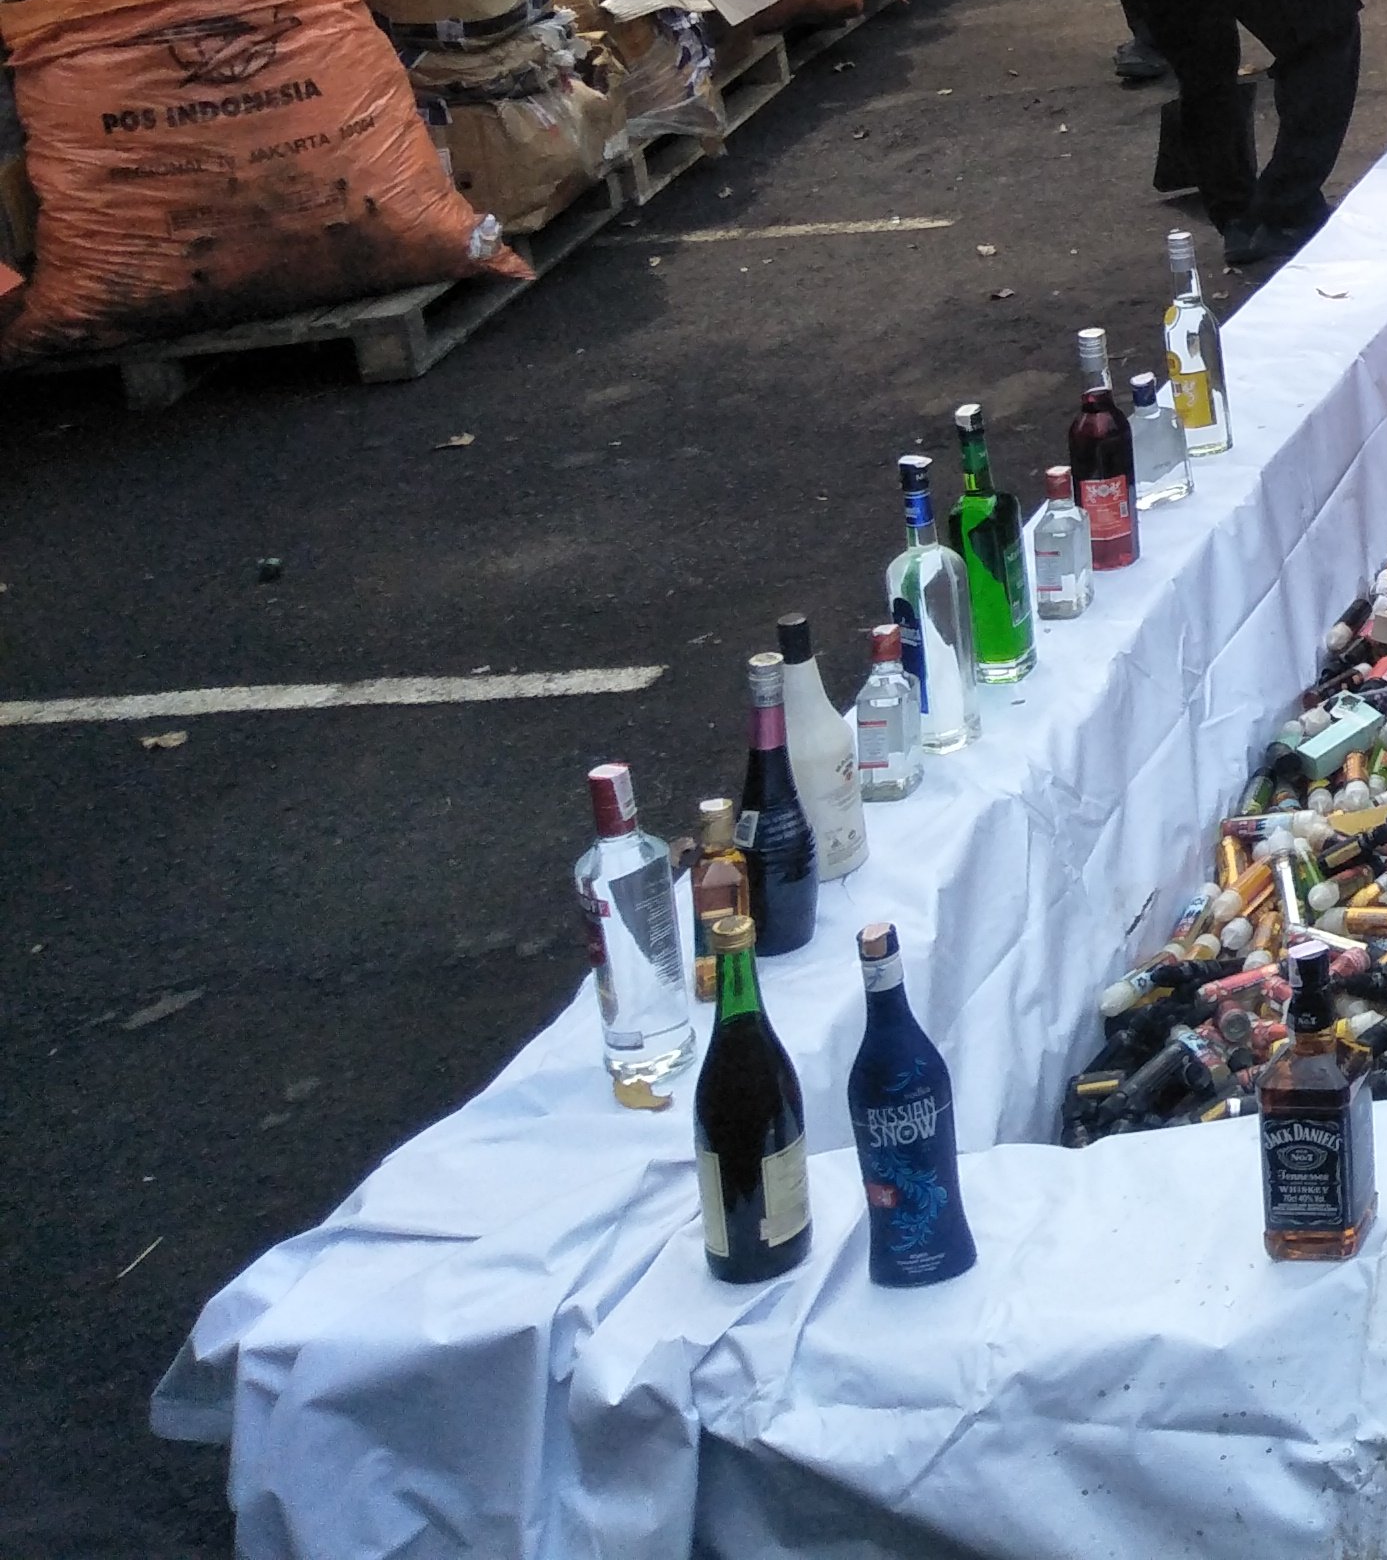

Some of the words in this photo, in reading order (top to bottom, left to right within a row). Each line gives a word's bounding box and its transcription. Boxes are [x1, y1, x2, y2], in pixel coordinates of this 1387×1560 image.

[102, 107, 157, 134] POS
[166, 78, 323, 127] INDONESIA
[867, 1095, 936, 1127] RUSSIAN
[869, 1112, 938, 1148] SNOW
[1264, 1127, 1294, 1151] JACK
[1293, 1123, 1344, 1152] DANIEL'S
[1278, 1185, 1331, 1194] WHISKEY
